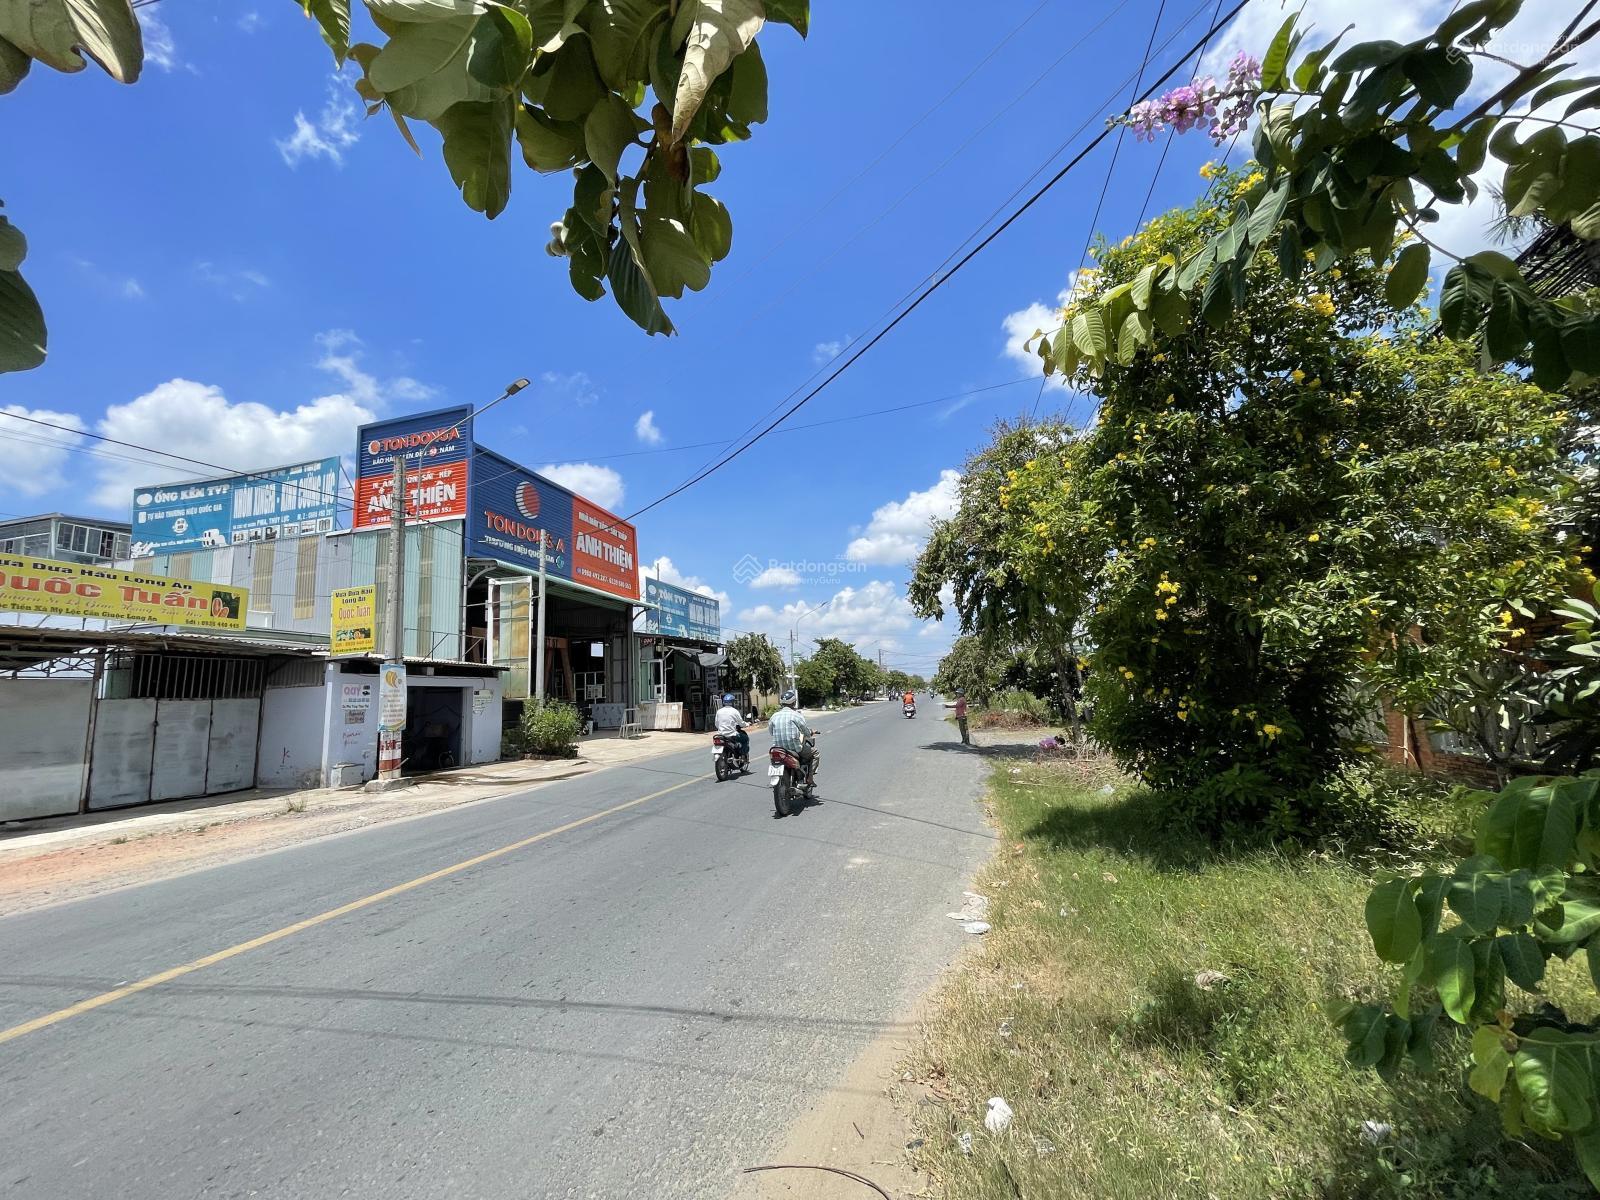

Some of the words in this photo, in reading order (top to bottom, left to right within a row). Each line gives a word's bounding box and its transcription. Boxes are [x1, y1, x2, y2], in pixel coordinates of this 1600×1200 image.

[207, 484, 230, 496] TVP
[124, 575, 166, 587] Long
[171, 582, 192, 590] An
[0, 570, 102, 598] uốc
[118, 586, 208, 610] Tuấn
[126, 613, 146, 621] Long
